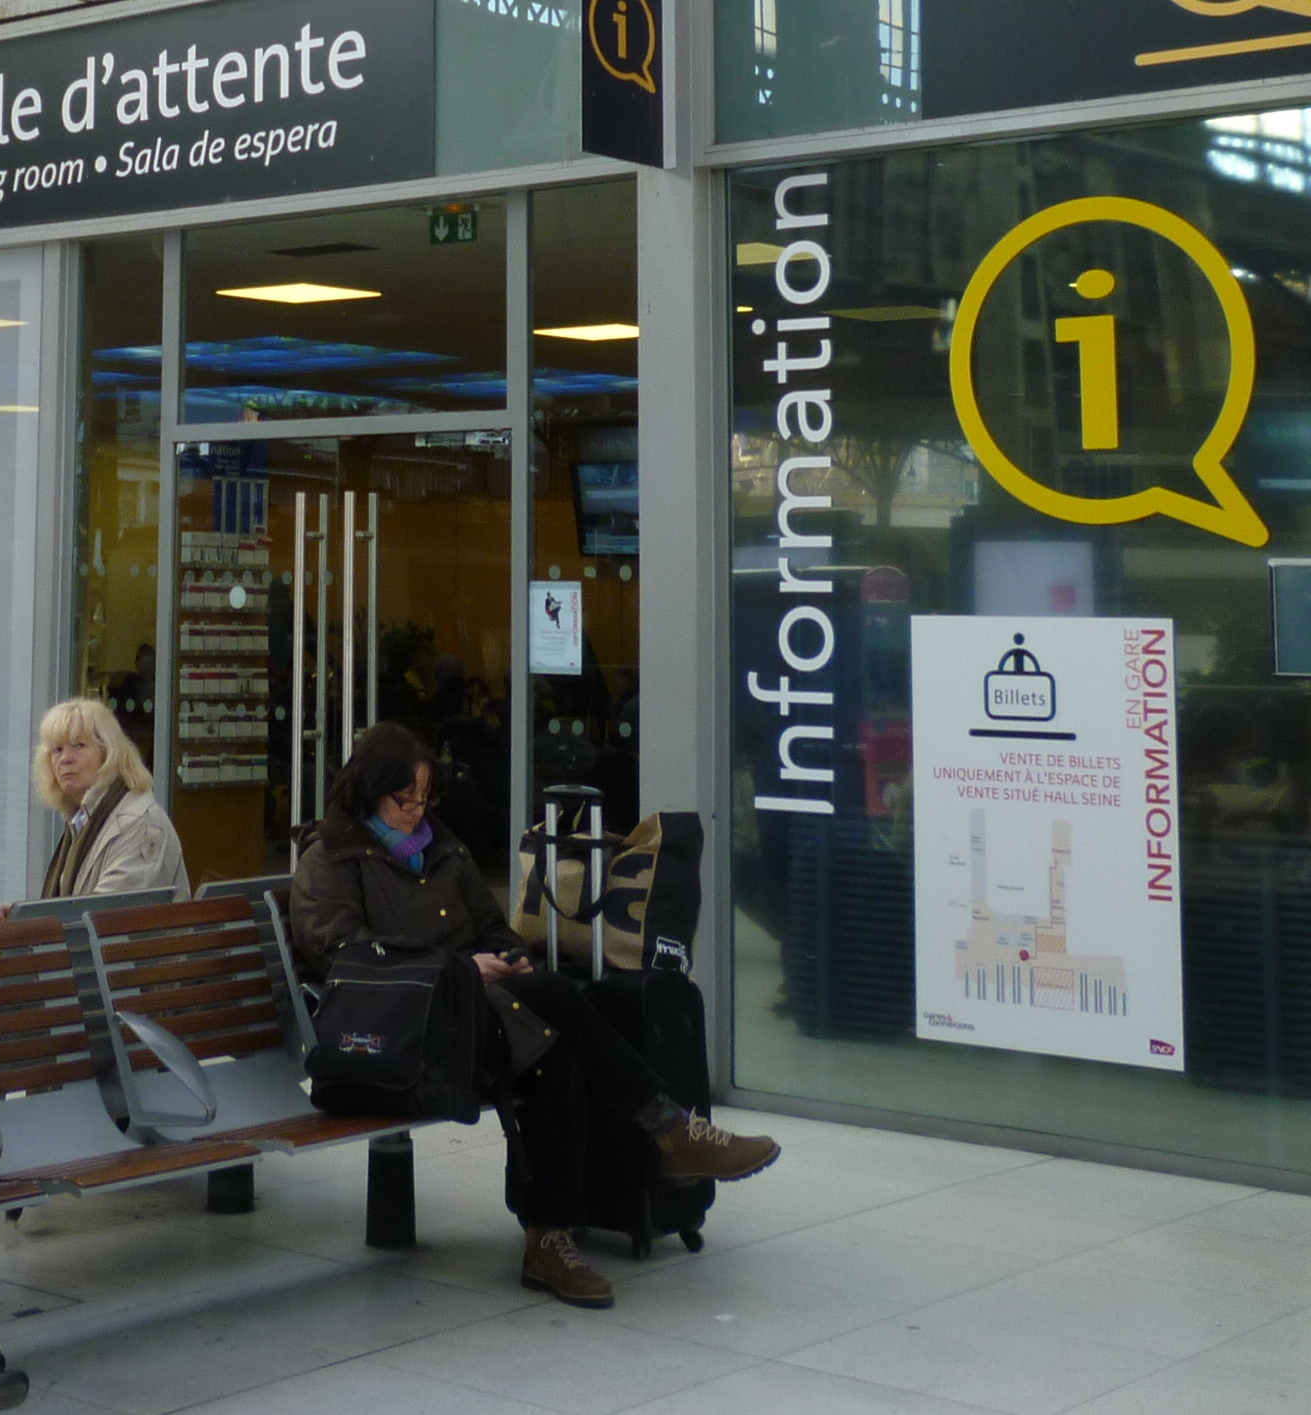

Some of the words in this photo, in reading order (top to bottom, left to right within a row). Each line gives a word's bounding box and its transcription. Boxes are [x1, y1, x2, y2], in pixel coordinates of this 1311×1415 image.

[61, 22, 366, 134] d'attente
[12, 157, 85, 194] room
[115, 137, 180, 178] Sala
[189, 130, 226, 168] de
[233, 118, 338, 167] espera
[748, 172, 835, 814] Information
[1124, 629, 1140, 691] GARE
[993, 689, 1047, 707] Billets
[1126, 699, 1142, 729] EN
[933, 767, 1020, 783] UNIQUEMENT
[1024, 766, 1034, 783] À
[1038, 771, 1098, 788] L'ESPACE
[1103, 775, 1121, 788] DE
[999, 752, 1043, 767] VENTE
[1047, 754, 1065, 768] DE
[1069, 755, 1121, 770] BILLETS
[1141, 629, 1173, 902] INFORMATION
[957, 785, 1000, 800] VENTE
[1003, 786, 1040, 802] SITUÉ
[1044, 789, 1078, 805] HALL
[1082, 792, 1121, 807] SEINE
